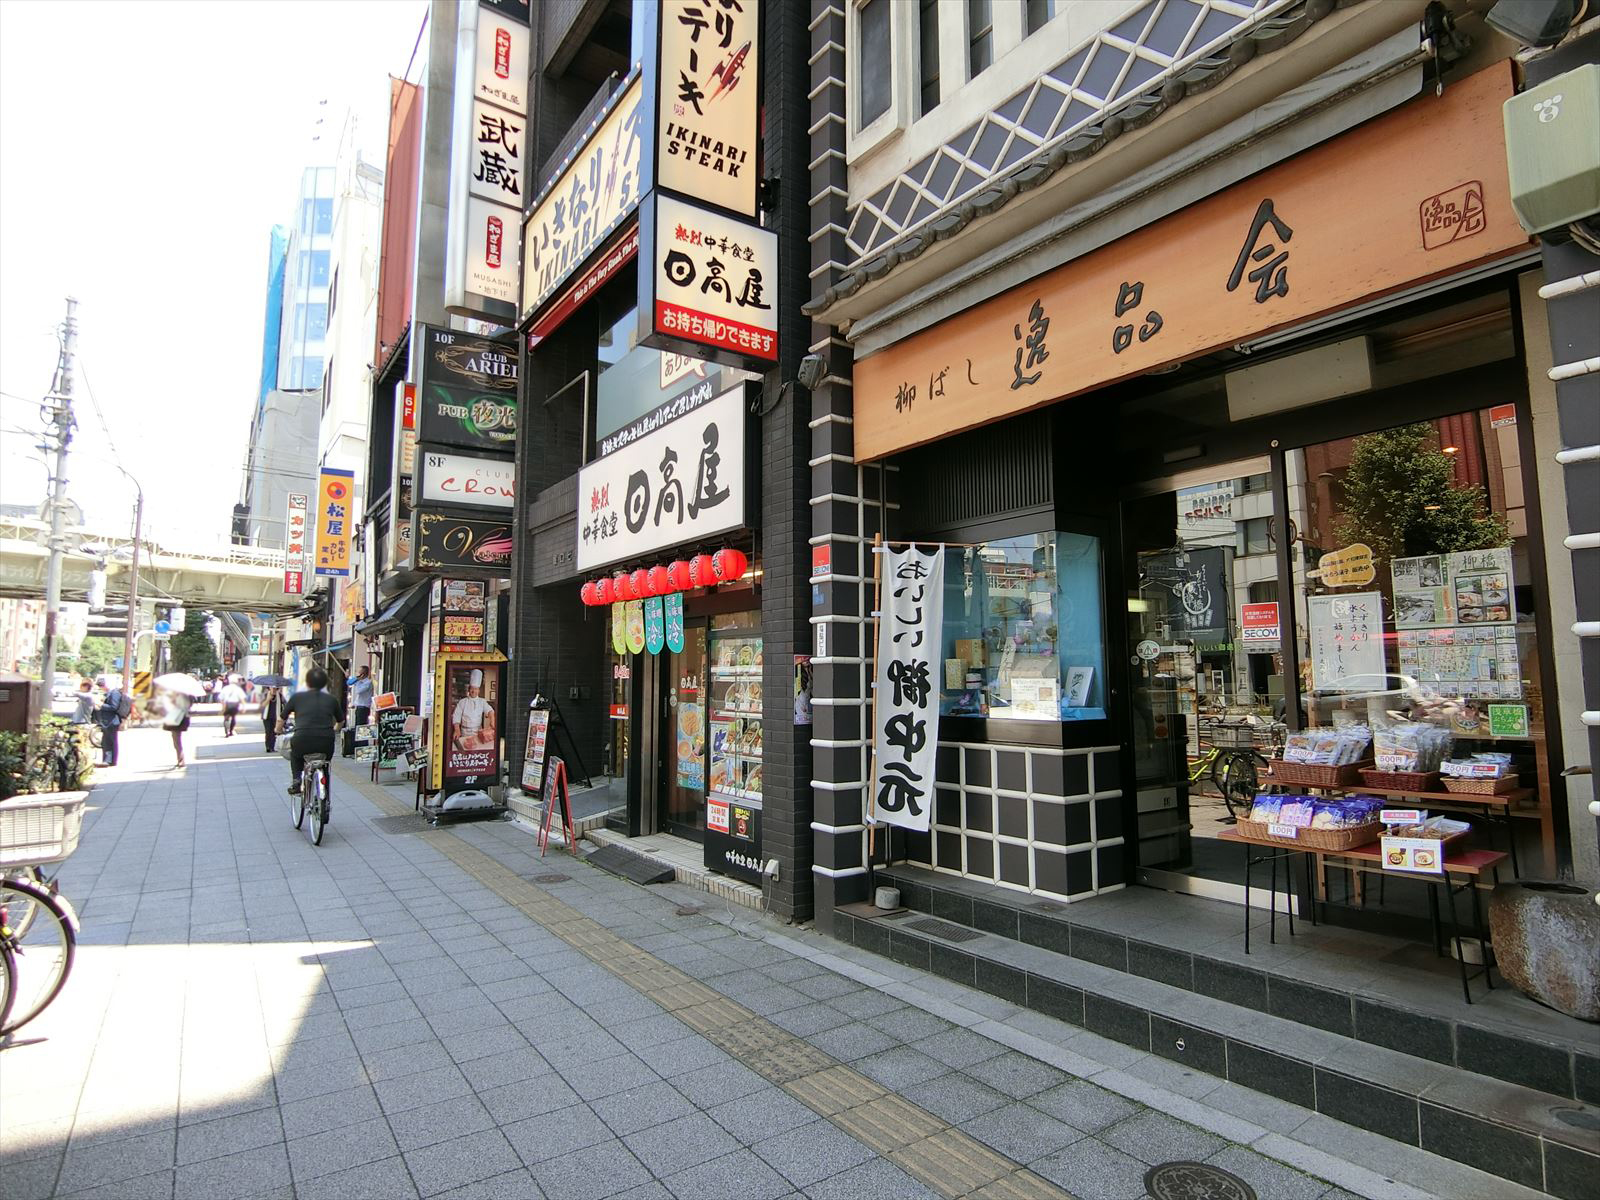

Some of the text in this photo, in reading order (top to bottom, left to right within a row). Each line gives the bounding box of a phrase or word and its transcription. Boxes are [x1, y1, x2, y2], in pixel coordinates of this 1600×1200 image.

[474, 113, 521, 196] 武蔵
[666, 122, 747, 163] IKINARI
[668, 140, 741, 178] STEAK
[533, 147, 603, 272] いきなり
[538, 207, 600, 298] IKINARI
[473, 272, 511, 287] MUSASHI
[664, 249, 771, 310] 日高屋
[435, 333, 455, 344] 10F
[663, 308, 774, 352] お持ち帰りできます
[481, 352, 507, 363] CLUB
[894, 358, 979, 414] 柳ばし
[438, 404, 468, 418] PUB
[429, 456, 446, 467] 8F
[475, 469, 510, 479] CLUB
[624, 422, 730, 534] 日高屋
[326, 502, 346, 535] 松屋
[583, 511, 619, 546] 中華食堂
[1463, 554, 1496, 570] 柳橋
[1244, 629, 1278, 638] SECOM
[1271, 825, 1293, 836] 100円
